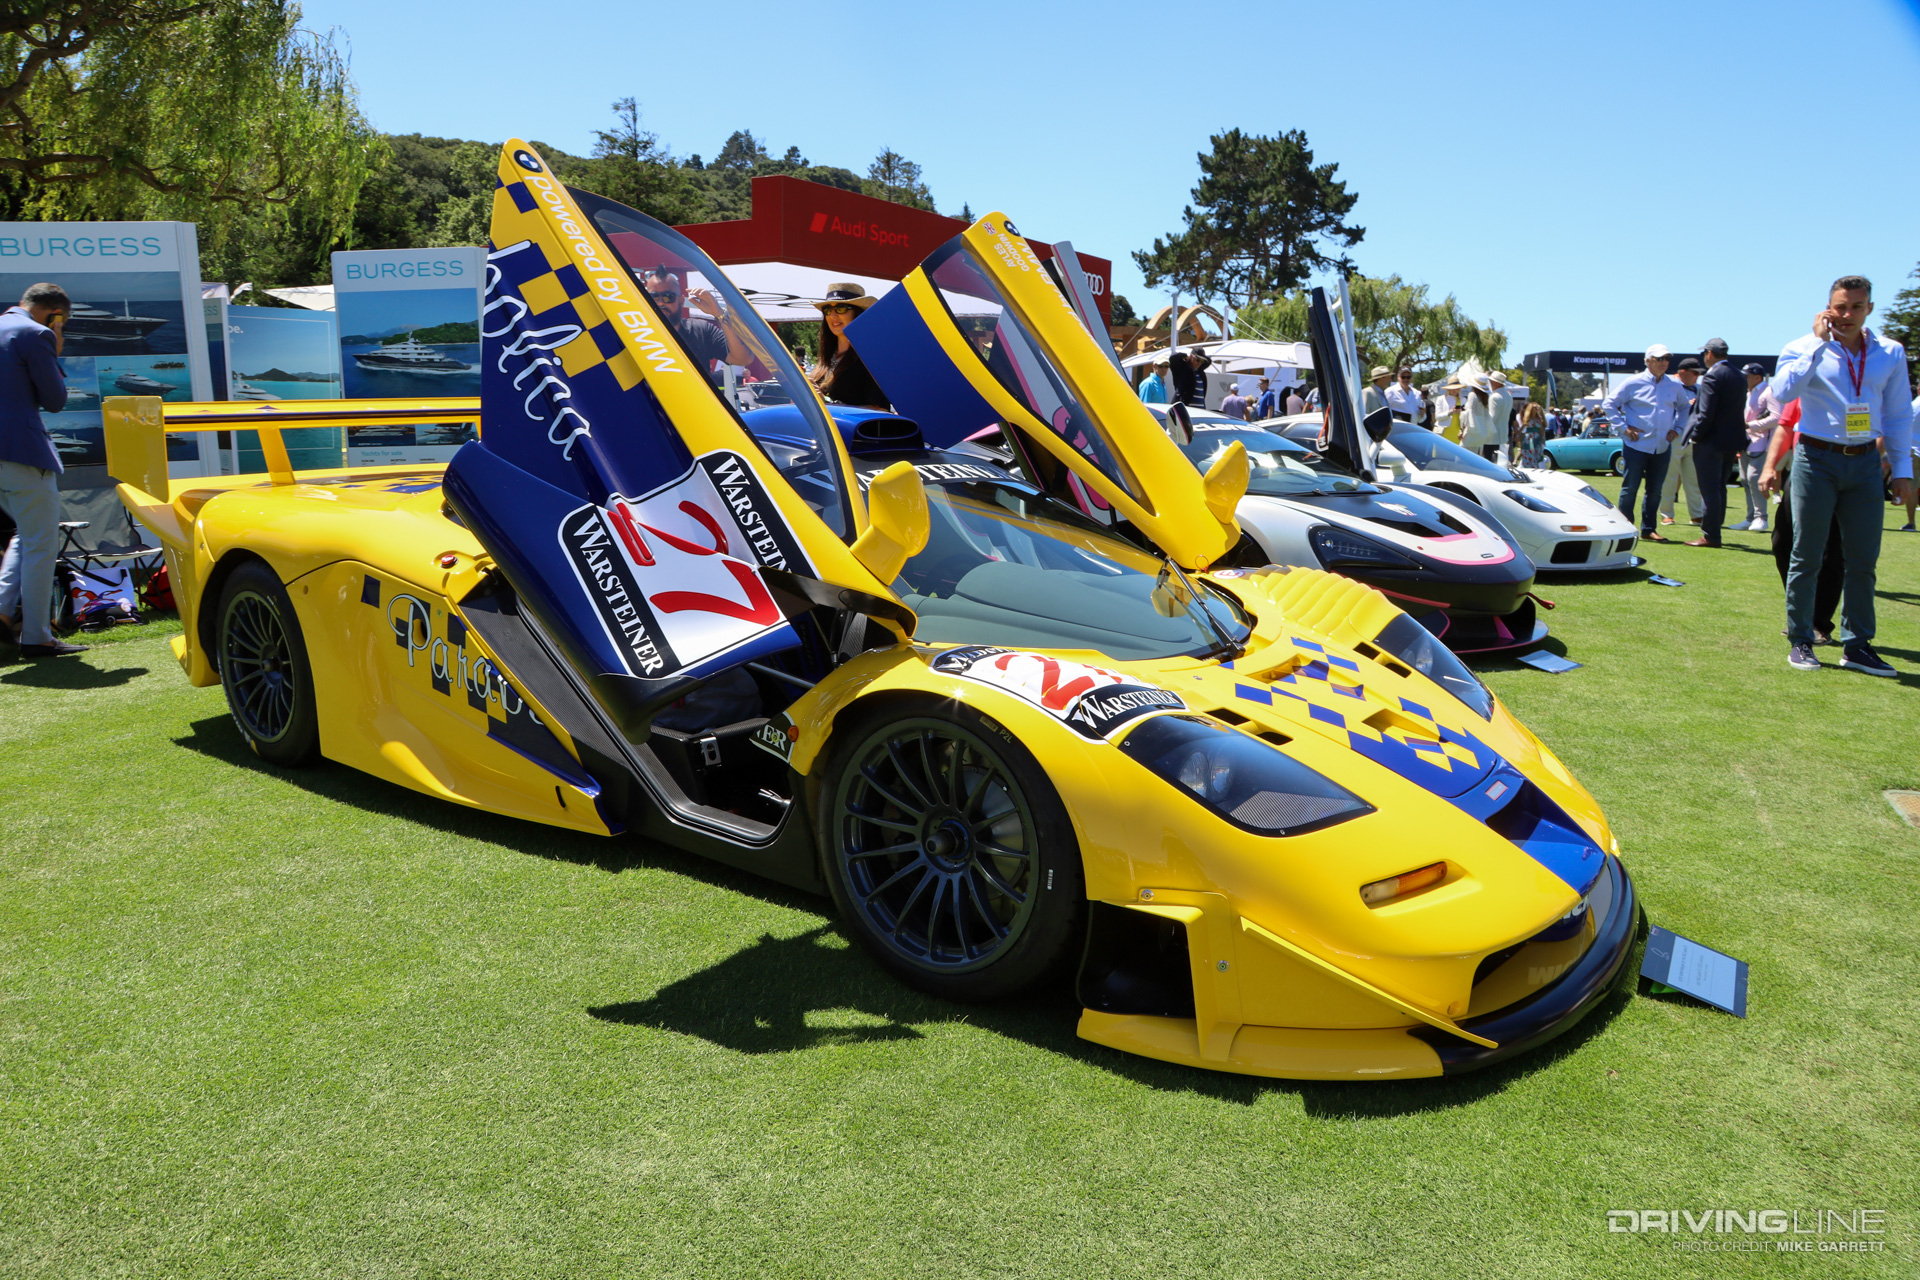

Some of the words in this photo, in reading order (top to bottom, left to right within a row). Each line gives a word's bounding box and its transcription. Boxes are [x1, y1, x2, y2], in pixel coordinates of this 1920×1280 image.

[0, 236, 162, 257] BURGESS
[831, 215, 866, 239] Audi
[870, 223, 910, 248] Sport
[993, 243, 1018, 268] AYLES
[996, 233, 1030, 272] GOODWIN
[346, 260, 464, 280] BURGESS
[524, 175, 613, 274] powered
[595, 277, 630, 305] by
[618, 310, 684, 374] BMW
[1573, 355, 1627, 366] Koenigegg
[573, 512, 664, 677] WARSTEINER
[1071, 690, 1181, 729] WARSTEINER
